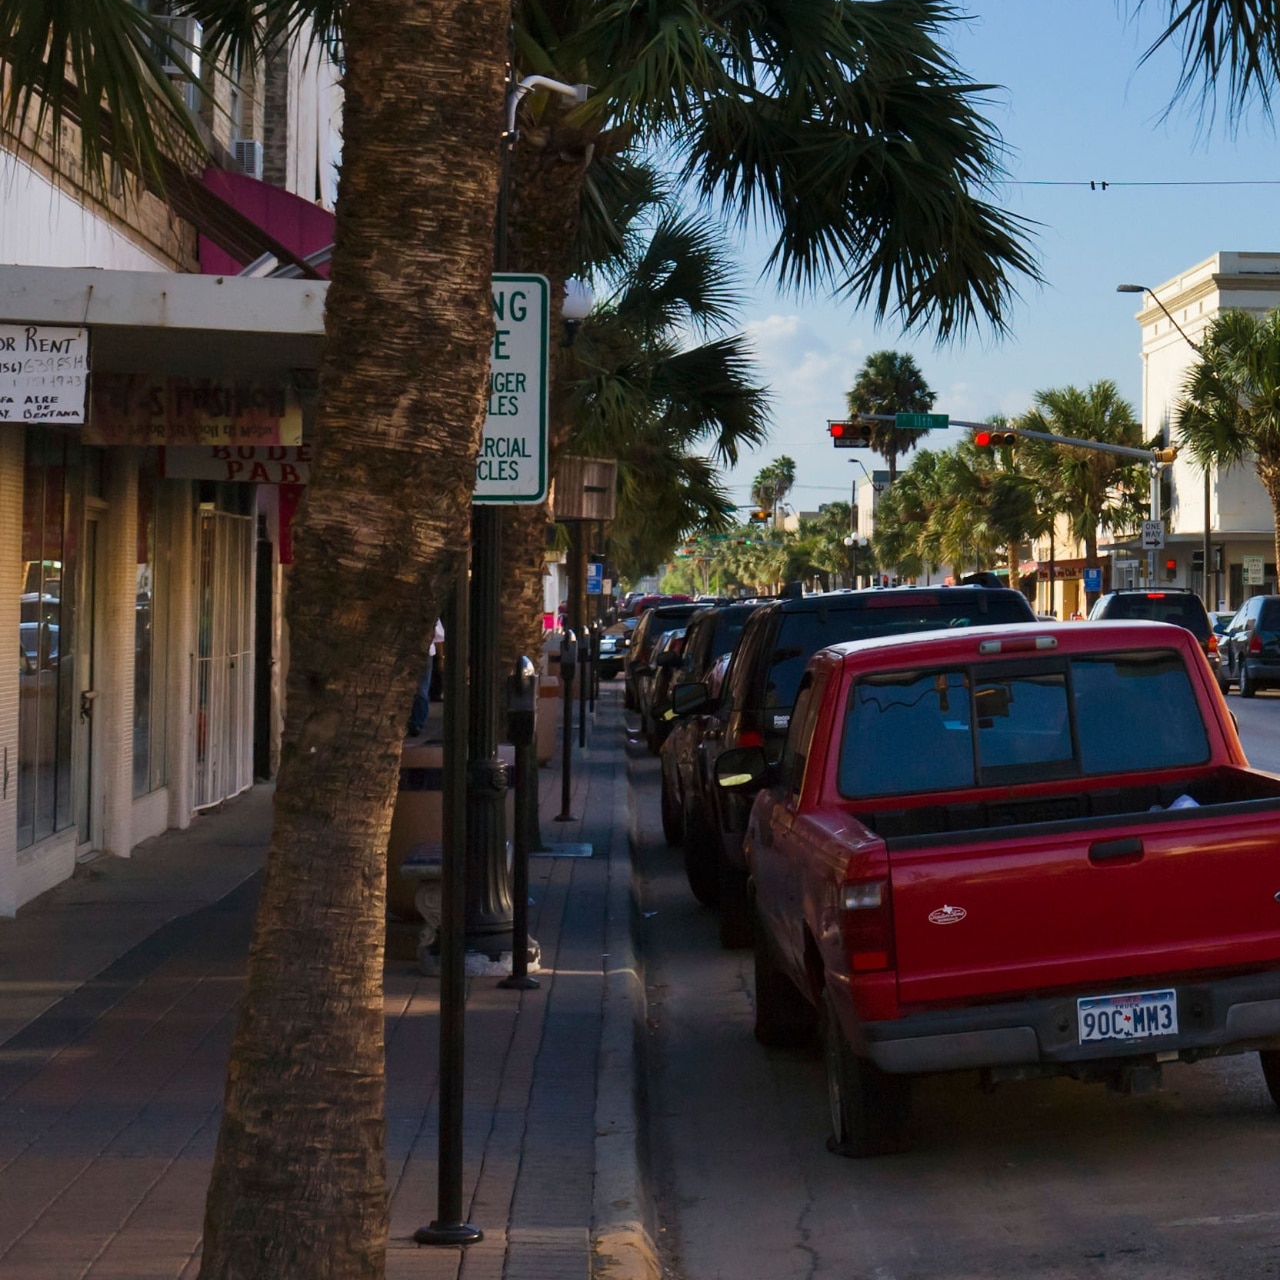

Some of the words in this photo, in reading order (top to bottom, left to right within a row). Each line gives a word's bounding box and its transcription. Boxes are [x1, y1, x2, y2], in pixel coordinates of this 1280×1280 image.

[24, 326, 77, 354] RENT
[24, 395, 59, 405] AIRE
[486, 396, 519, 416] LES
[23, 408, 80, 419] BENTANA
[226, 460, 301, 484] PAB
[1145, 522, 1161, 530] ONE
[1145, 530, 1162, 538] WAY
[1114, 1002, 1140, 1010] TRUCK
